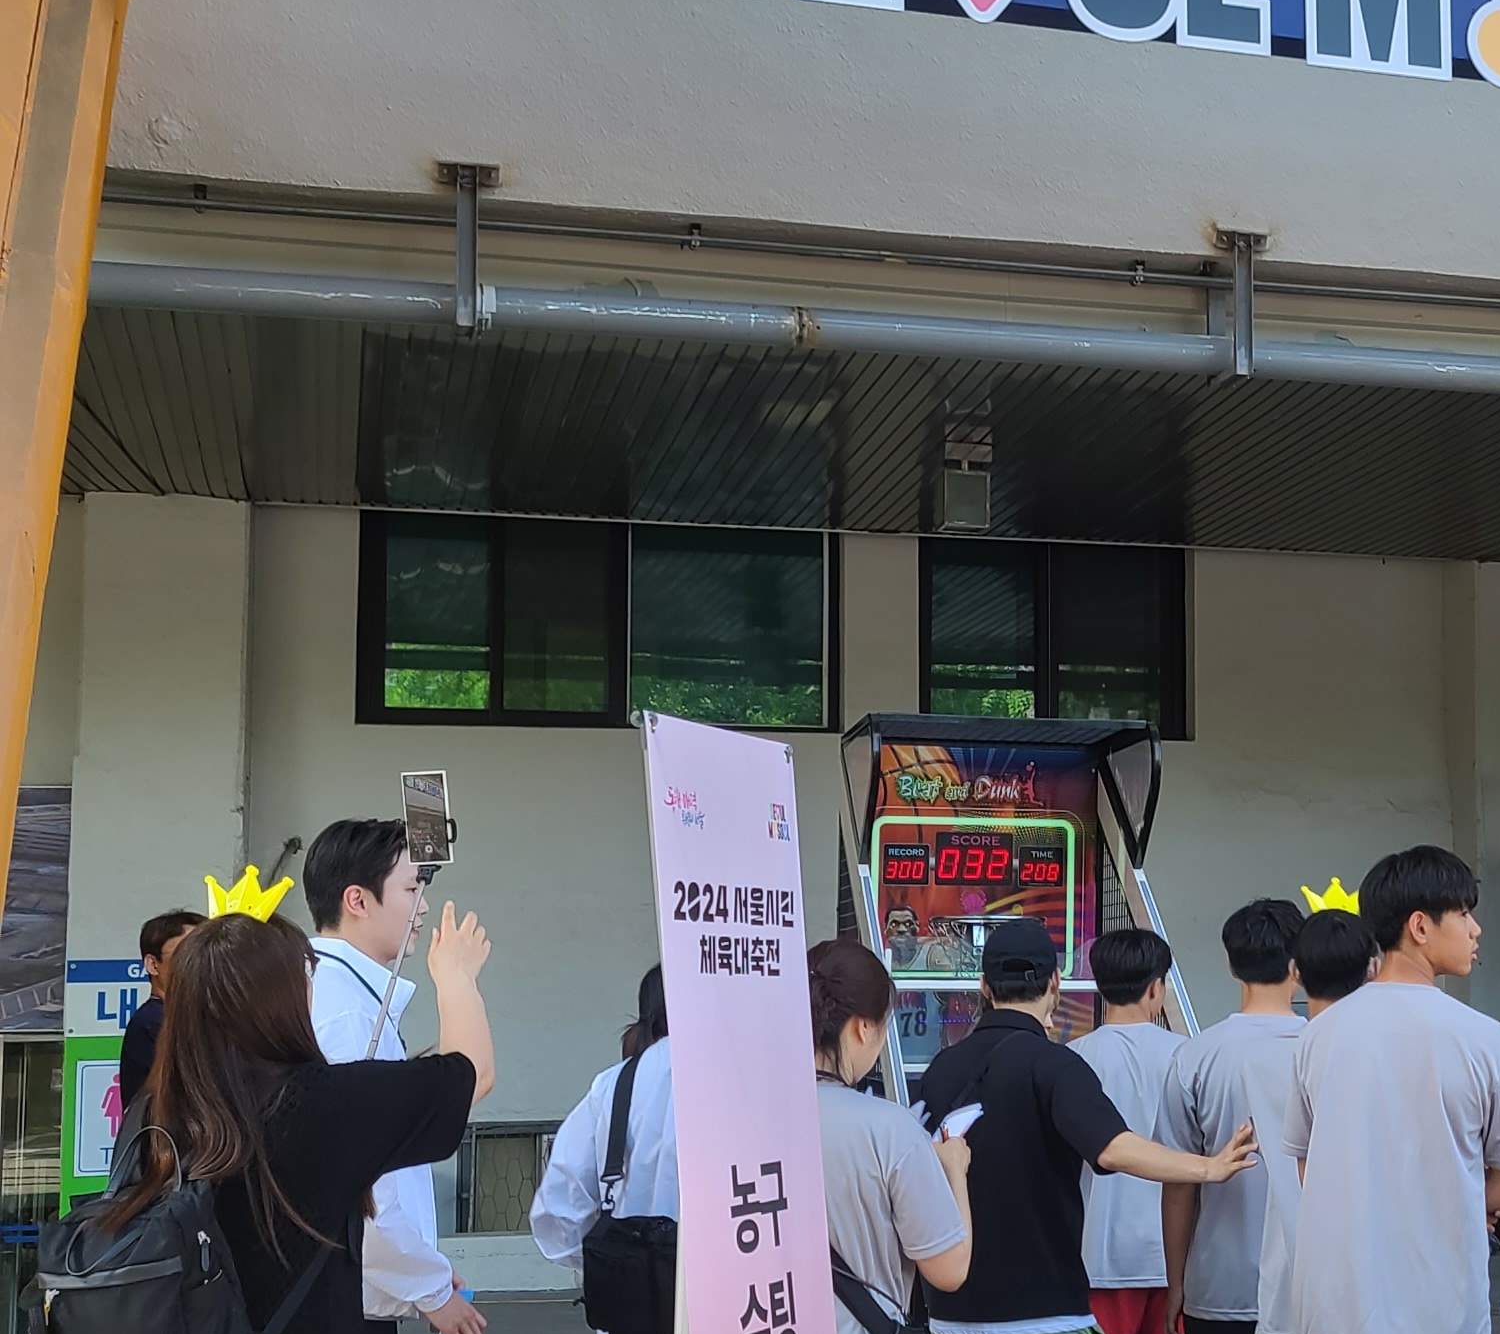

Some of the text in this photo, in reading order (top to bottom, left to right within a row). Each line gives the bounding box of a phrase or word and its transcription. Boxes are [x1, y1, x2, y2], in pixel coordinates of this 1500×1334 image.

[888, 848, 925, 857] RECORD
[951, 835, 1001, 846] SCORE
[1030, 850, 1054, 859] TIME
[937, 848, 1010, 881] 032
[673, 880, 794, 928] 2024 서울시민
[699, 934, 781, 977] 체육대축전
[730, 1160, 788, 1254] 농구
